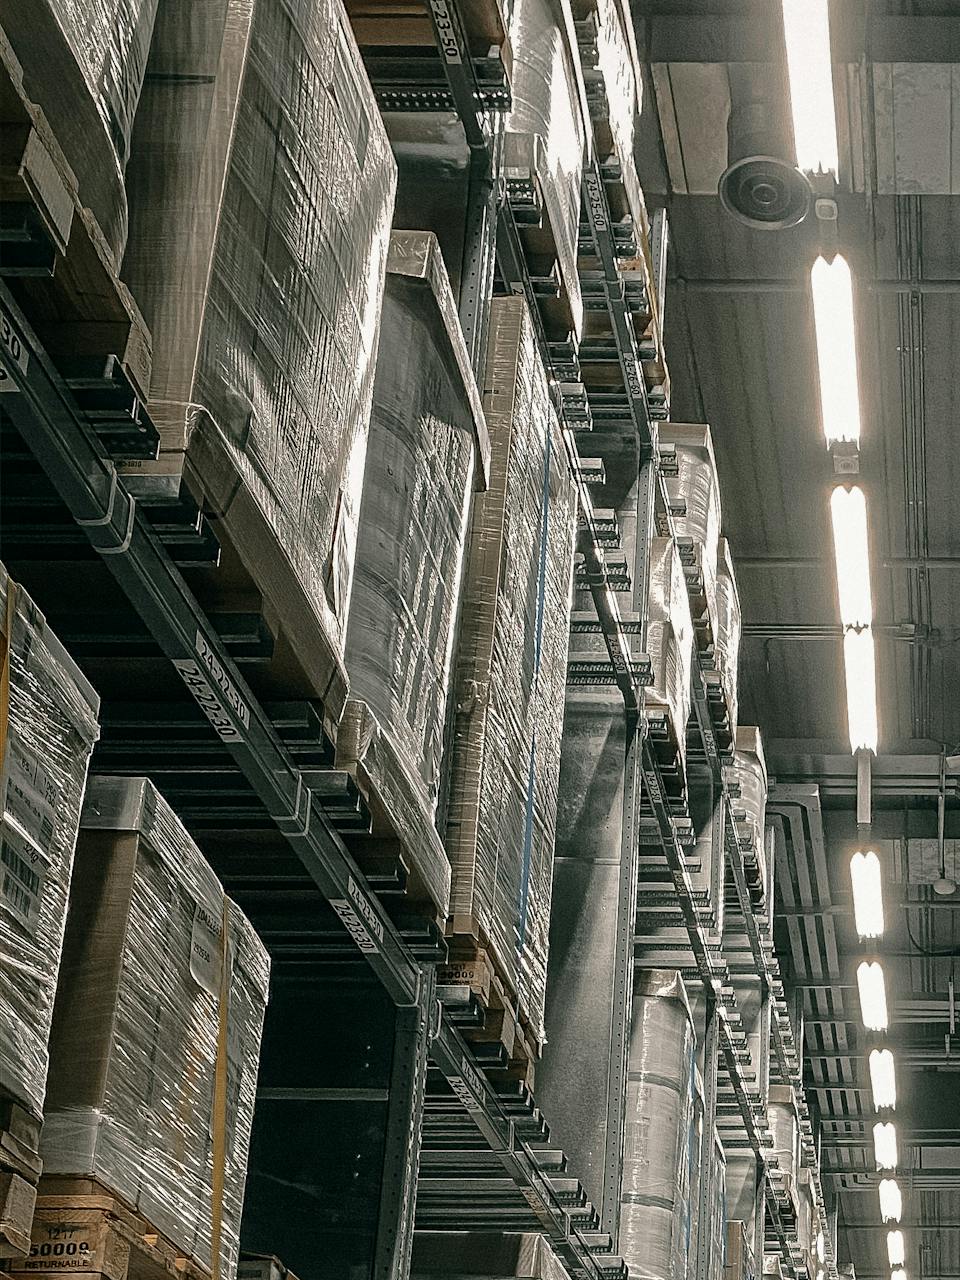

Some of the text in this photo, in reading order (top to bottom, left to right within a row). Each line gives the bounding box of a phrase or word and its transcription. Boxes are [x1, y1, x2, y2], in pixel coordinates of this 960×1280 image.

[435, 0, 457, 56] -23-50
[587, 180, 604, 226] 24-25-60
[623, 357, 640, 394] 24-26-60
[178, 667, 236, 735] 24-22-30
[335, 904, 375, 949] 24-23-30
[25, 1259, 89, 1269] RETURNABLE
[29, 1242, 90, 1257] 50009
